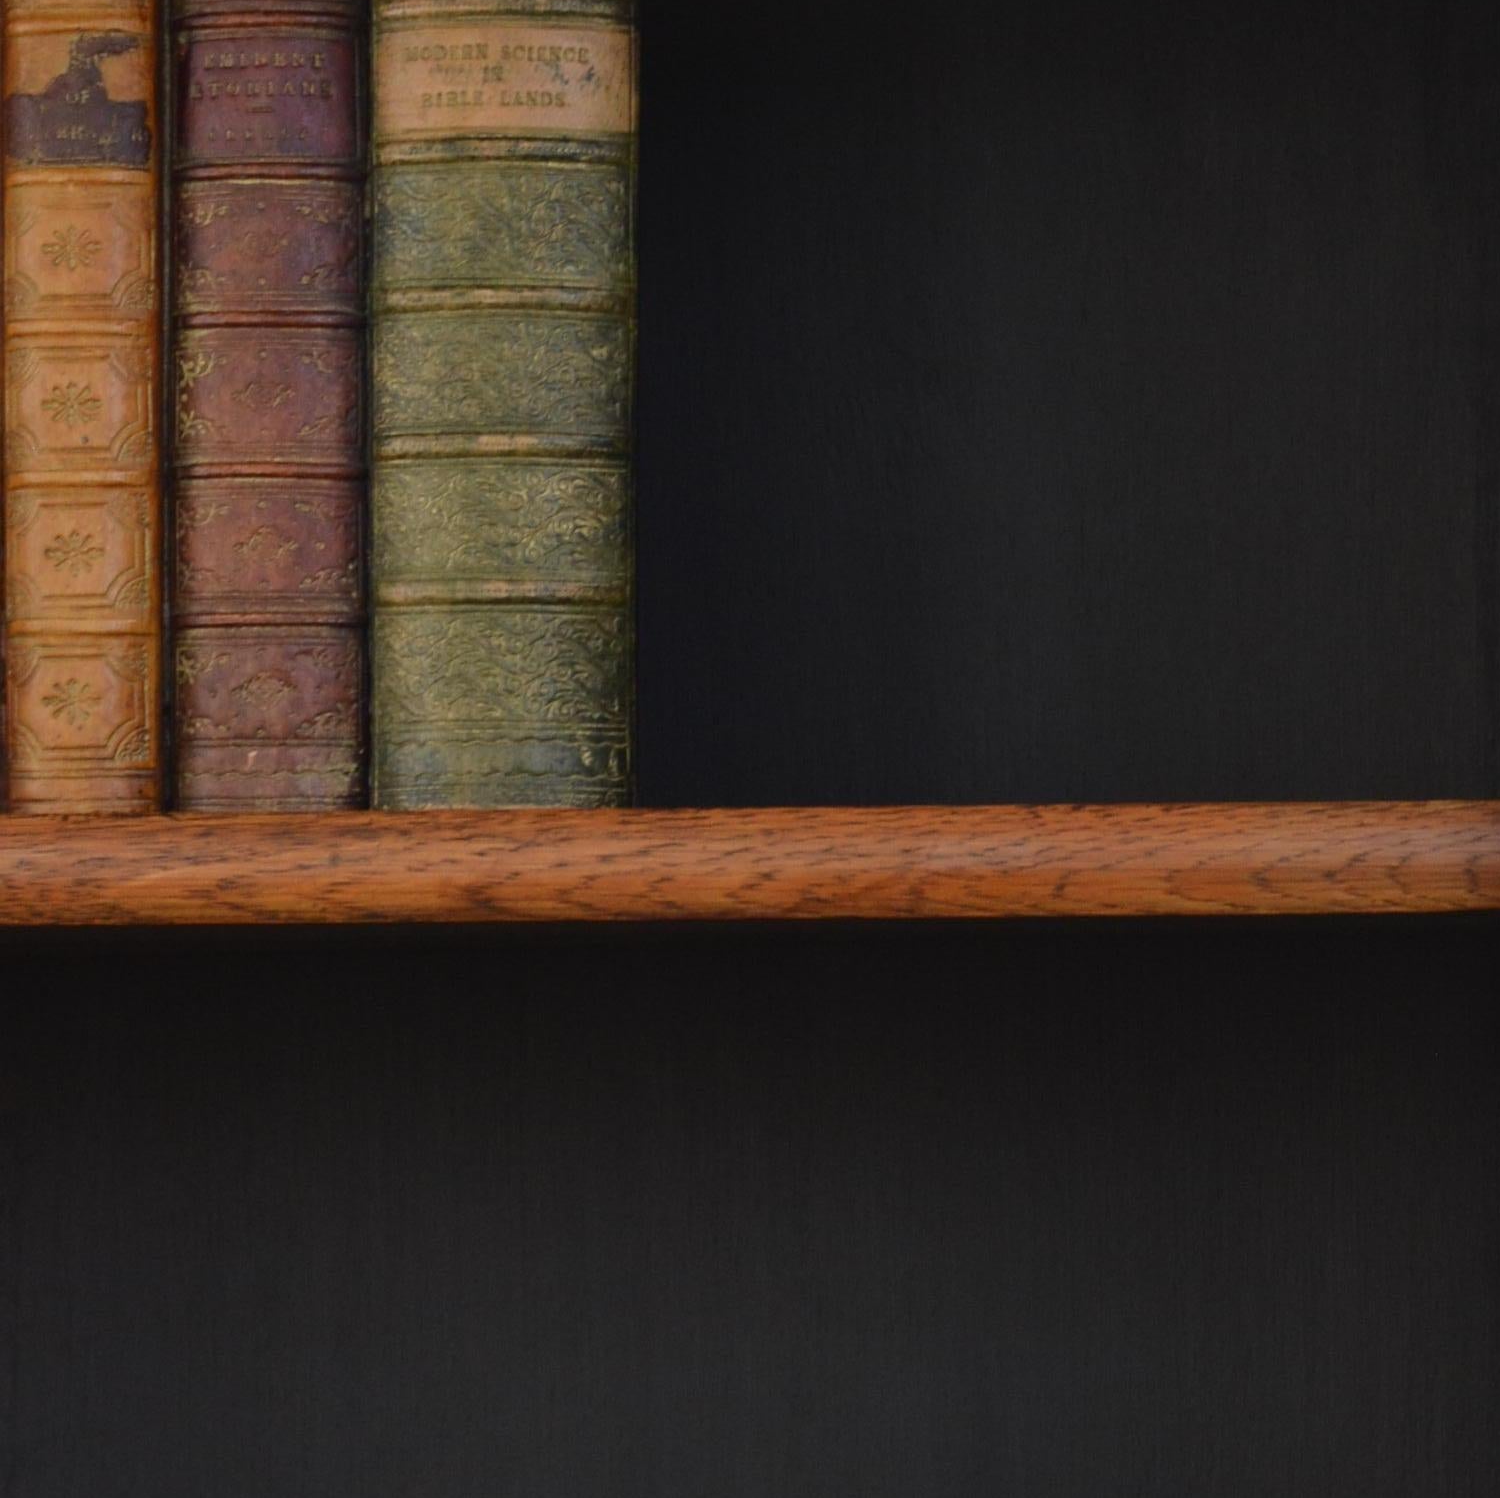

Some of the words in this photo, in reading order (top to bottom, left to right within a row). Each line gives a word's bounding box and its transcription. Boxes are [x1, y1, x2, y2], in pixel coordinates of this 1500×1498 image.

[403, 42, 490, 62] MODERN
[499, 44, 590, 64] SCIENCE
[420, 90, 485, 109] BIBLE
